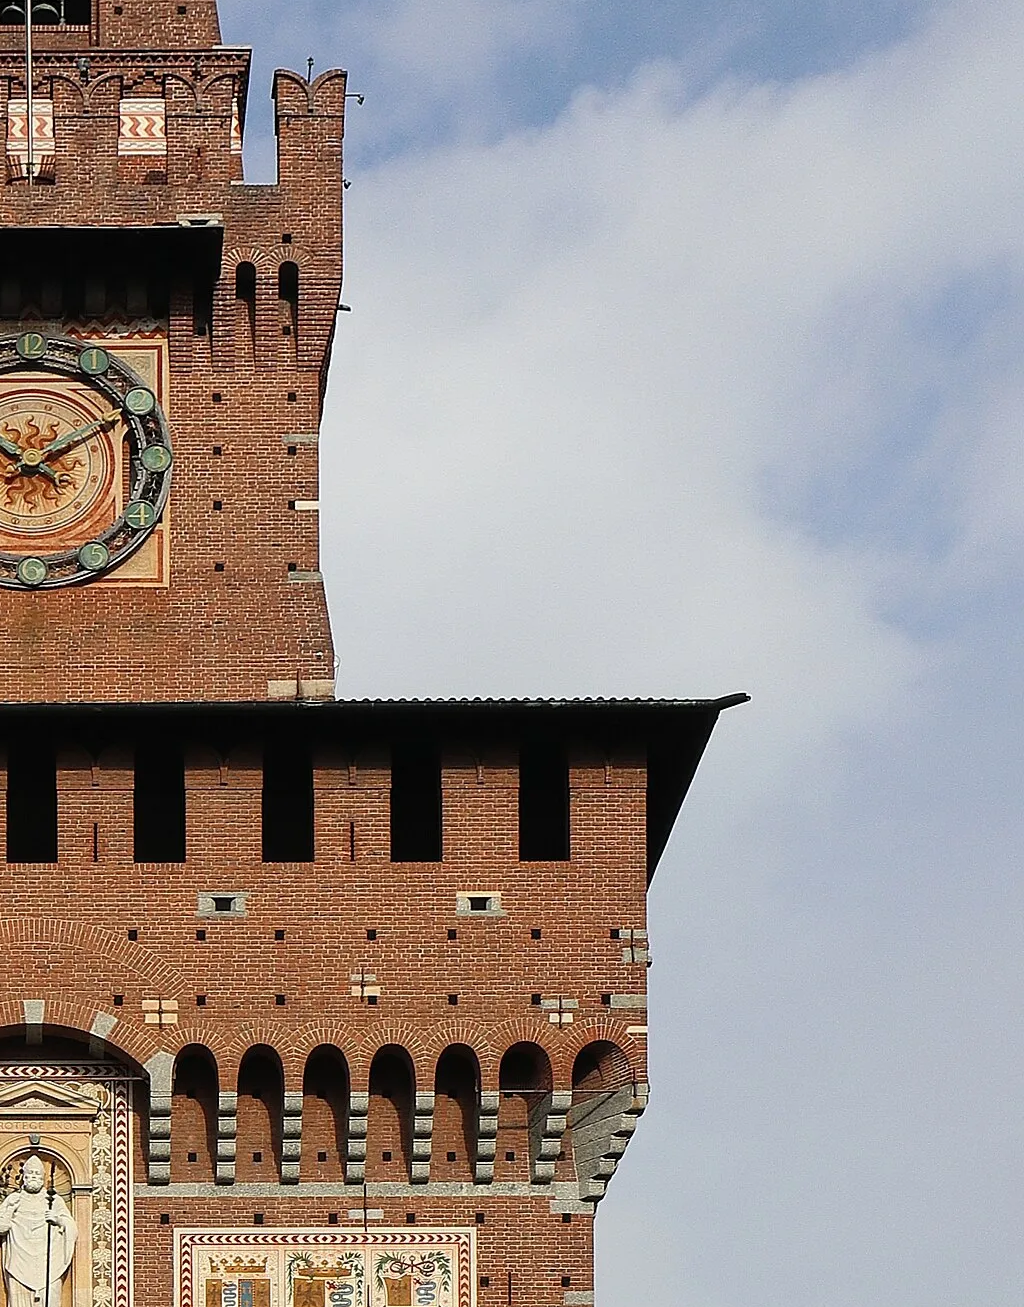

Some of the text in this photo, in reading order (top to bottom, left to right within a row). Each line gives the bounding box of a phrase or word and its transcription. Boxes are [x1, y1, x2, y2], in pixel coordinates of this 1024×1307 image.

[24, 333, 42, 356] 12
[88, 351, 99, 370] 1
[133, 392, 147, 411] 2
[152, 449, 164, 468] 3
[129, 505, 149, 526] 4
[89, 544, 102, 564] 5
[25, 561, 40, 582] 6
[55, 1121, 79, 1130] NOS
